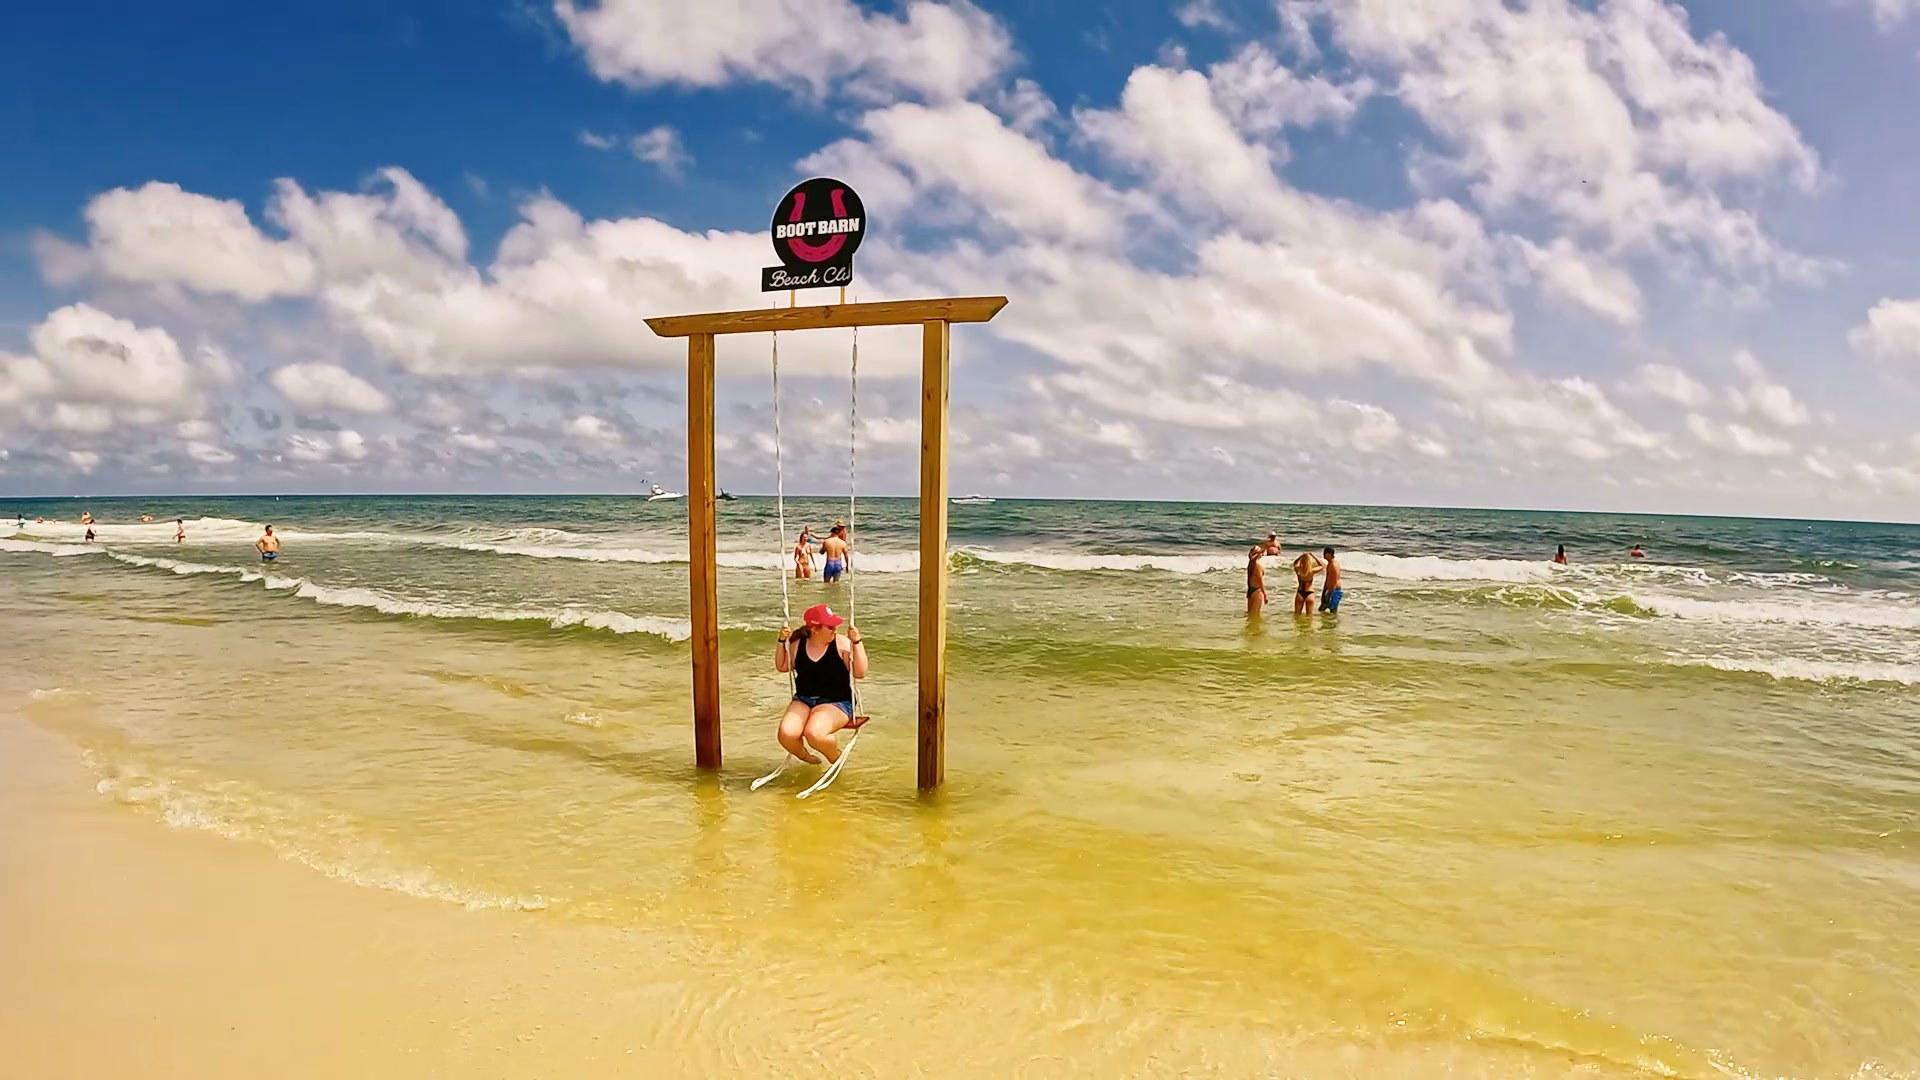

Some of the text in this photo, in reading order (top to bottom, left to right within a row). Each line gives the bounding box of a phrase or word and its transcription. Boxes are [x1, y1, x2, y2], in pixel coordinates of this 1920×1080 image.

[776, 217, 860, 239] BOOT BARN
[769, 268, 820, 287] Beach
